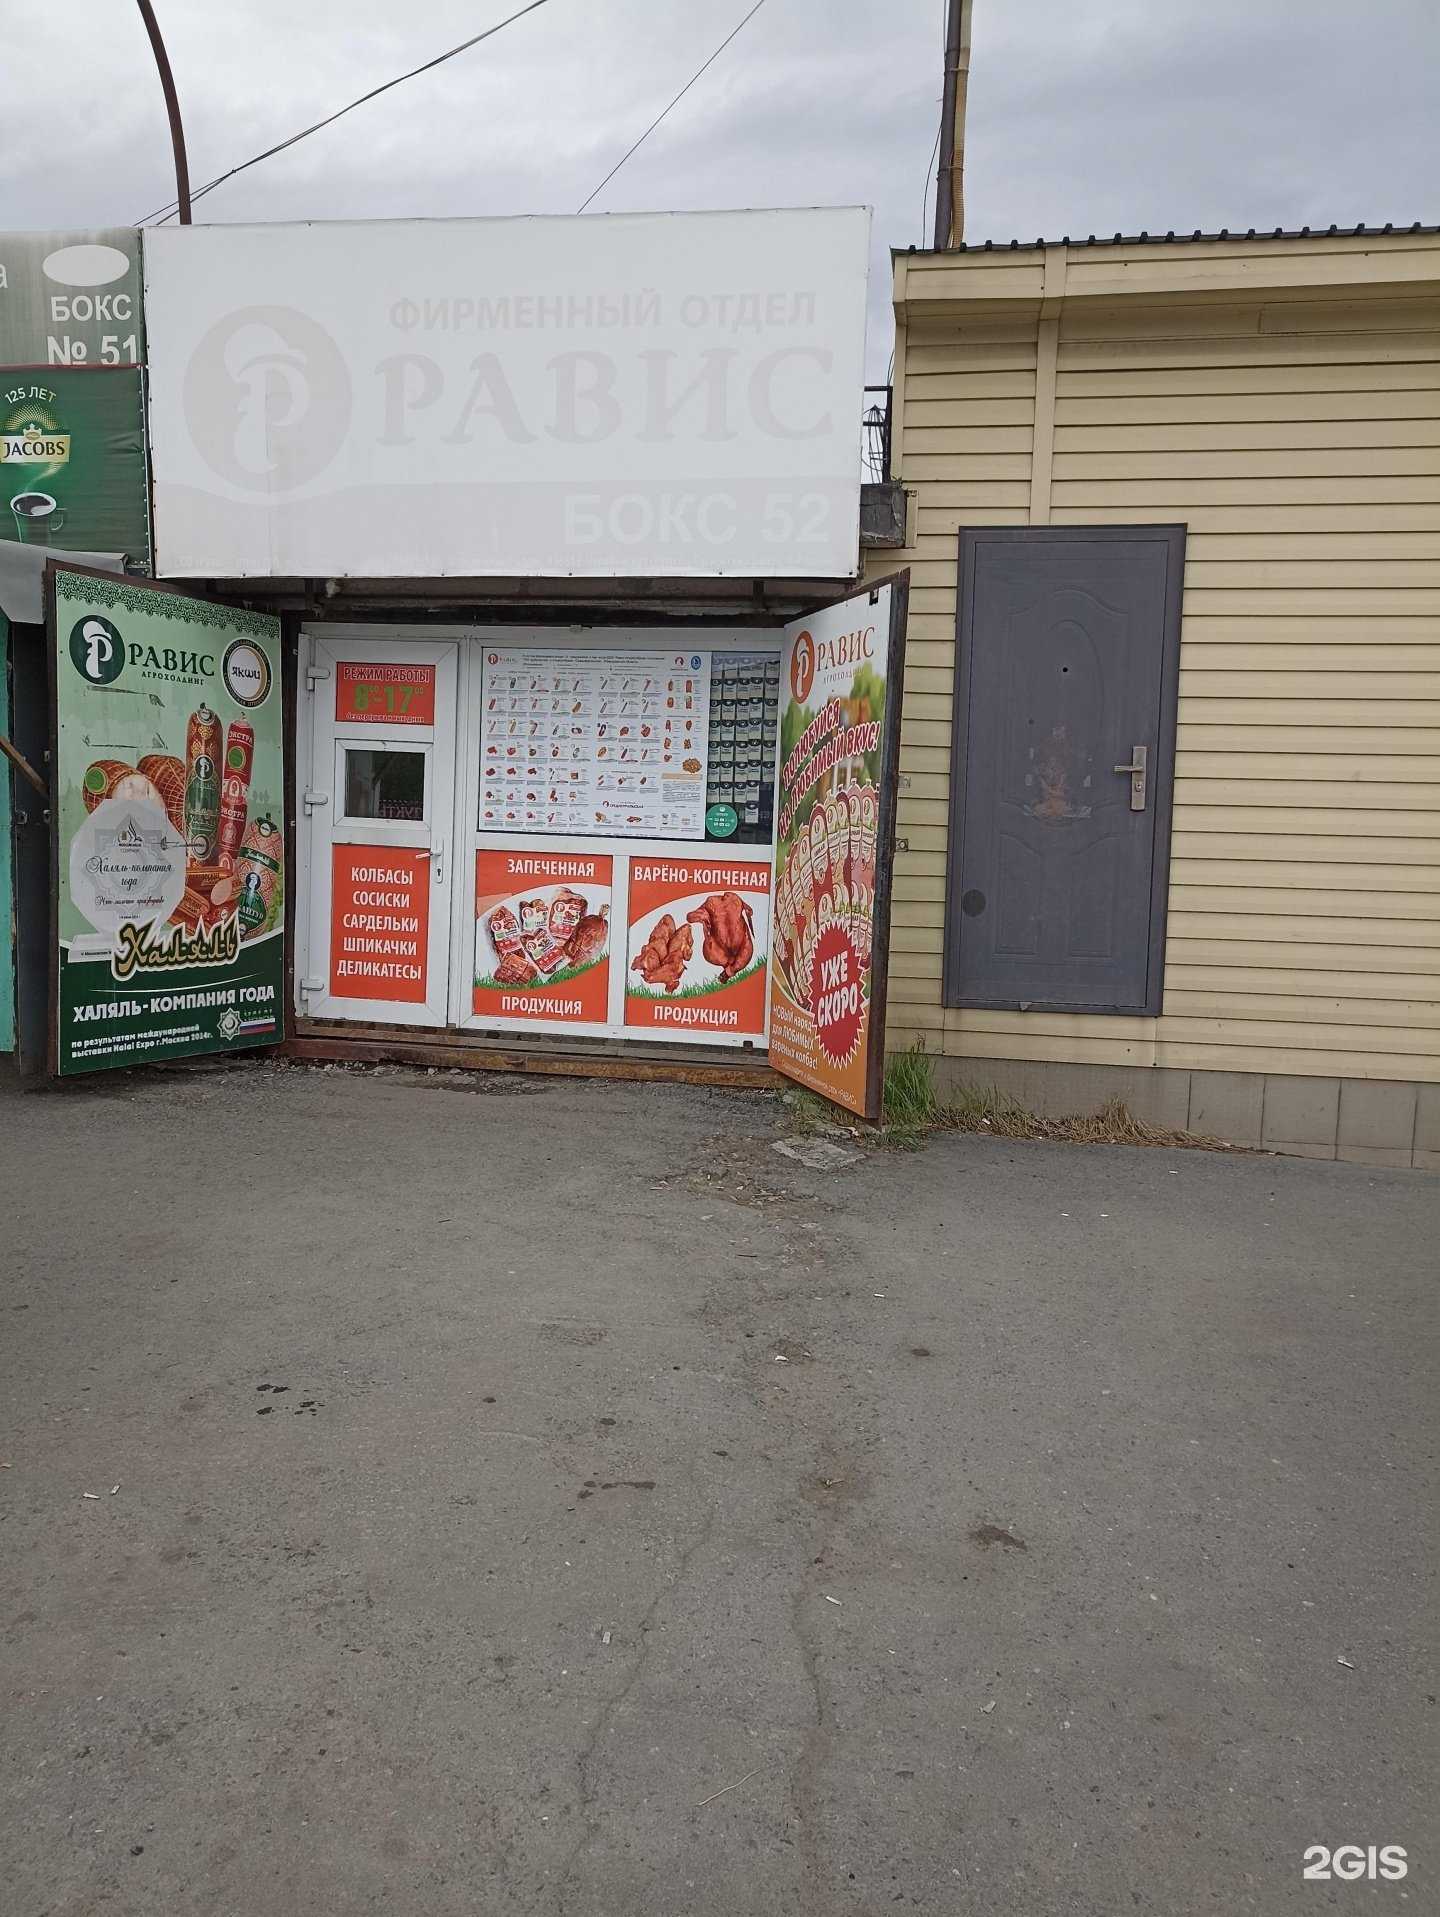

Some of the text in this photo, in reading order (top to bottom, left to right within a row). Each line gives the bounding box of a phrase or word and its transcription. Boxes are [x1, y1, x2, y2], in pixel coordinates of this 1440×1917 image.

[51, 294, 132, 322] БОКС
[388, 288, 816, 334] ФИРМЕННЫЙ ОТДЕЛ
[47, 335, 137, 366] № 51
[4, 386, 57, 404] 125 ЛЕТ
[374, 345, 833, 446] РАВИС
[3, 440, 66, 460] JACOBS
[564, 492, 830, 547] БОКС 52
[816, 627, 875, 671] РАВИС
[128, 643, 215, 677] РАВИС
[141, 671, 205, 685] АГРОХОЛДИНГ
[344, 667, 430, 683] РЕЖИМ РАБОТЫ
[782, 699, 841, 791] ПОЛЮБУЙСЯ
[779, 721, 881, 842] НА ЛЮБИМЫЙ ВКУС!
[351, 867, 413, 885] КОЛБАСЫ
[507, 859, 595, 877] ЗАПЕЧЕННАЯ
[634, 863, 768, 887] ВАРЁНО-КОПЧЕНАЯ
[353, 890, 410, 908] СОСИСКИ
[343, 914, 418, 932] САРДЕЛЬКИ
[115, 917, 238, 979] Халяль
[344, 938, 417, 956] ШПИКАЧКИ
[337, 960, 422, 980] ДЕЛИКАТЕСЫ
[820, 950, 848, 992] УЖЕ
[240, 986, 275, 1003] ГОДА
[501, 996, 582, 1016] ПРОДУКЦИЯ
[654, 1005, 738, 1026] ПРОДУКЦИЯ
[817, 983, 858, 1028] СКОРО
[72, 1041, 82, 1049] по
[84, 1034, 135, 1050] результатам
[72, 1047, 112, 1058] выставки
[136, 1041, 154, 1050] Expo
[771, 1039, 818, 1070] вареных колбас!
